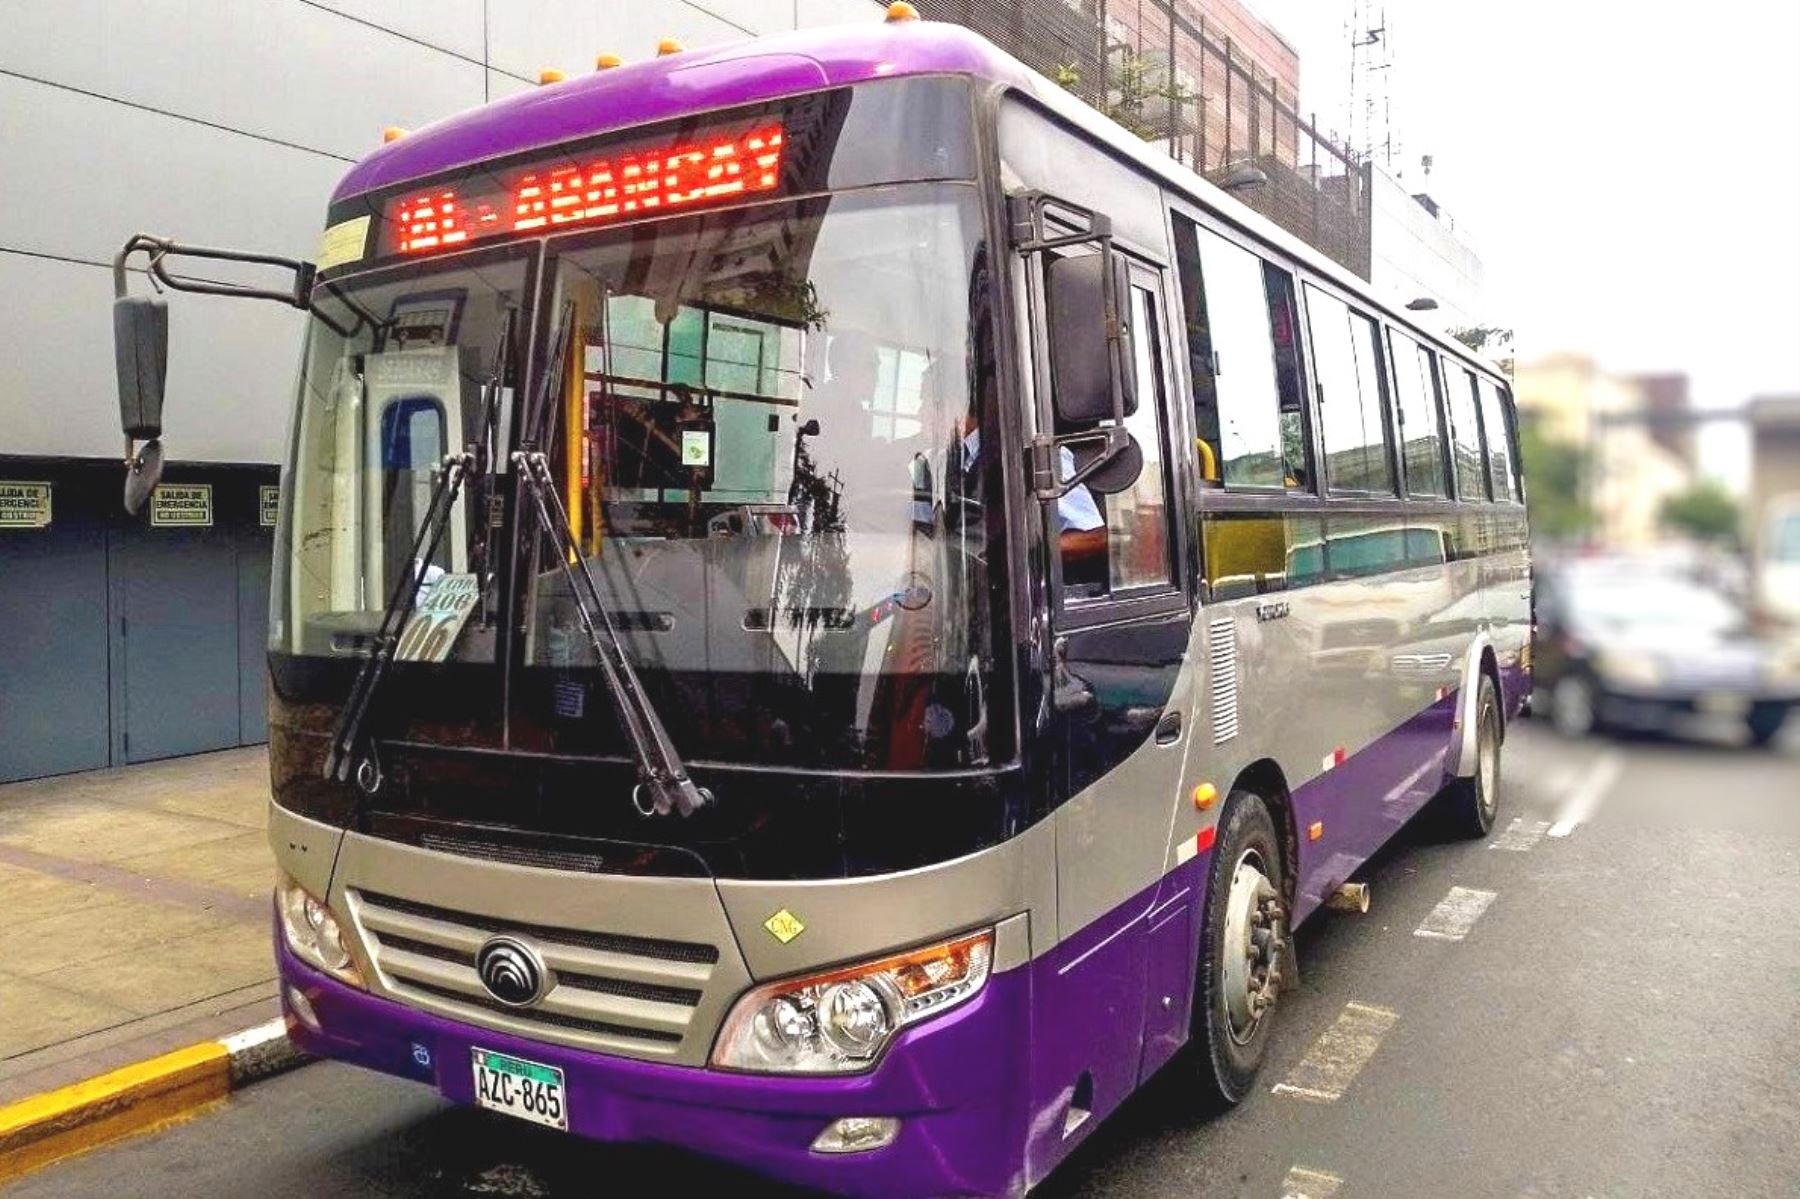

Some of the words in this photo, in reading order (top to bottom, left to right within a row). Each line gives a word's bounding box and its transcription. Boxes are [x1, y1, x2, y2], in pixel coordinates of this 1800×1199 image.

[399, 190, 468, 252] AL
[511, 127, 783, 231] ABANCAY
[160, 490, 188, 500] SALIDA
[501, 1059, 533, 1078] PERU
[479, 1066, 561, 1119] AZC-865
